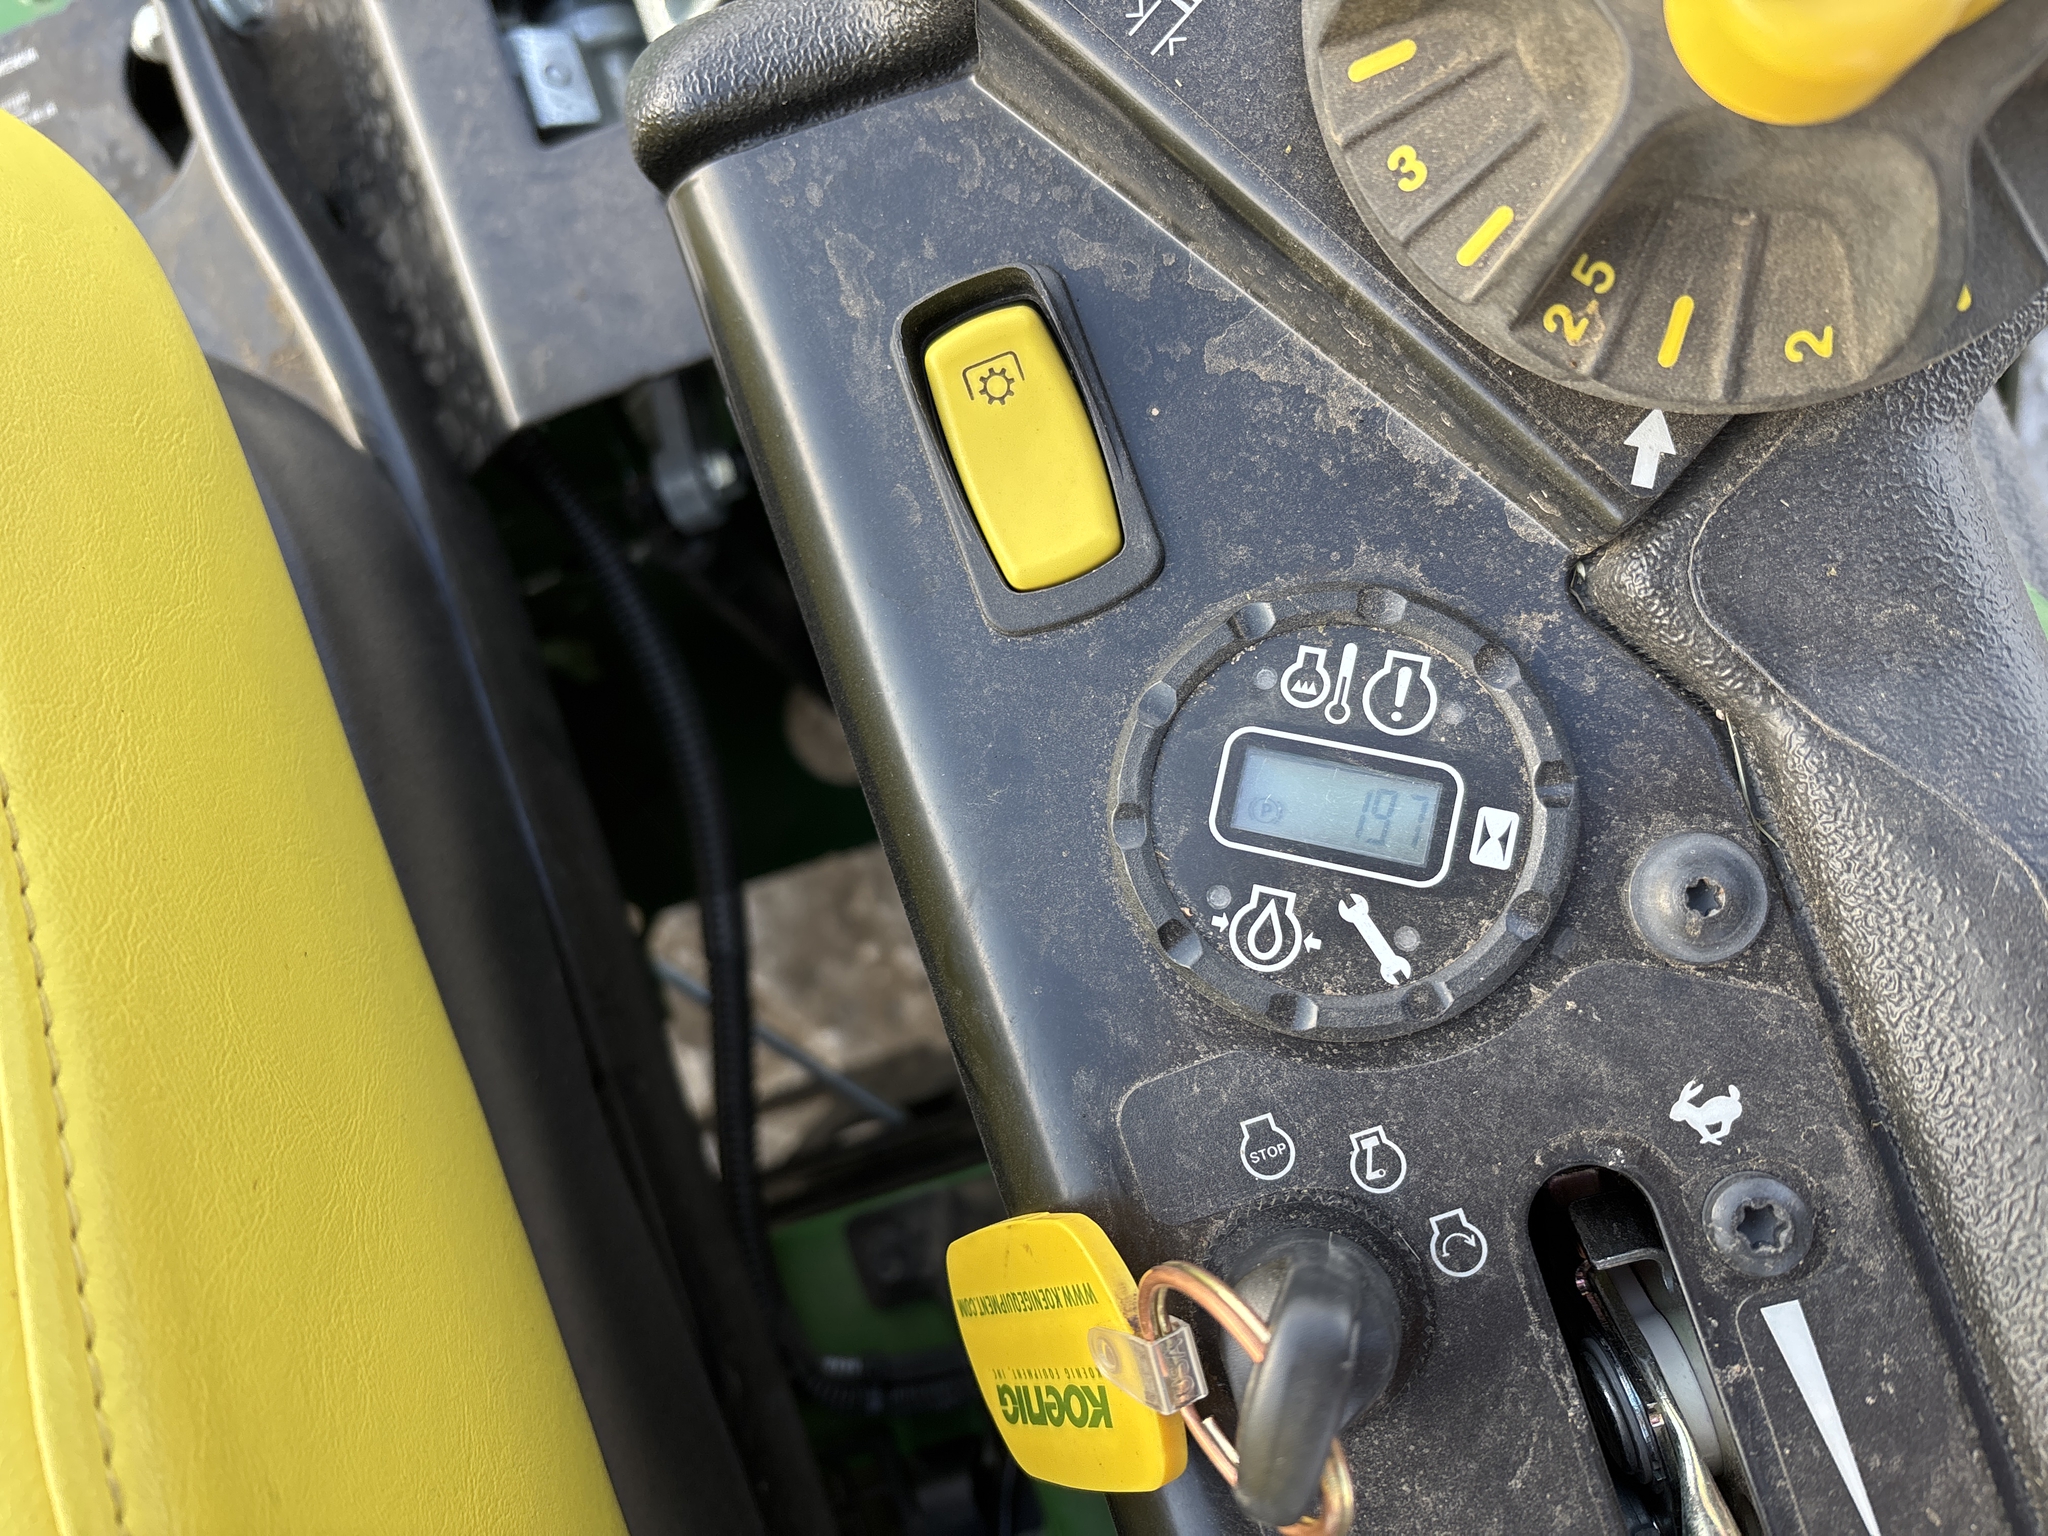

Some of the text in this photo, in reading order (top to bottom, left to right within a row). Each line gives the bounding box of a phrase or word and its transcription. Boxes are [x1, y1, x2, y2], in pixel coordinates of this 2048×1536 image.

[1386, 144, 1428, 192] 3
[1784, 325, 1834, 364] 2
[1249, 1142, 1287, 1164] STOP
[957, 1282, 1099, 1318] WWW.KOENIGEQUIPMENT.COM
